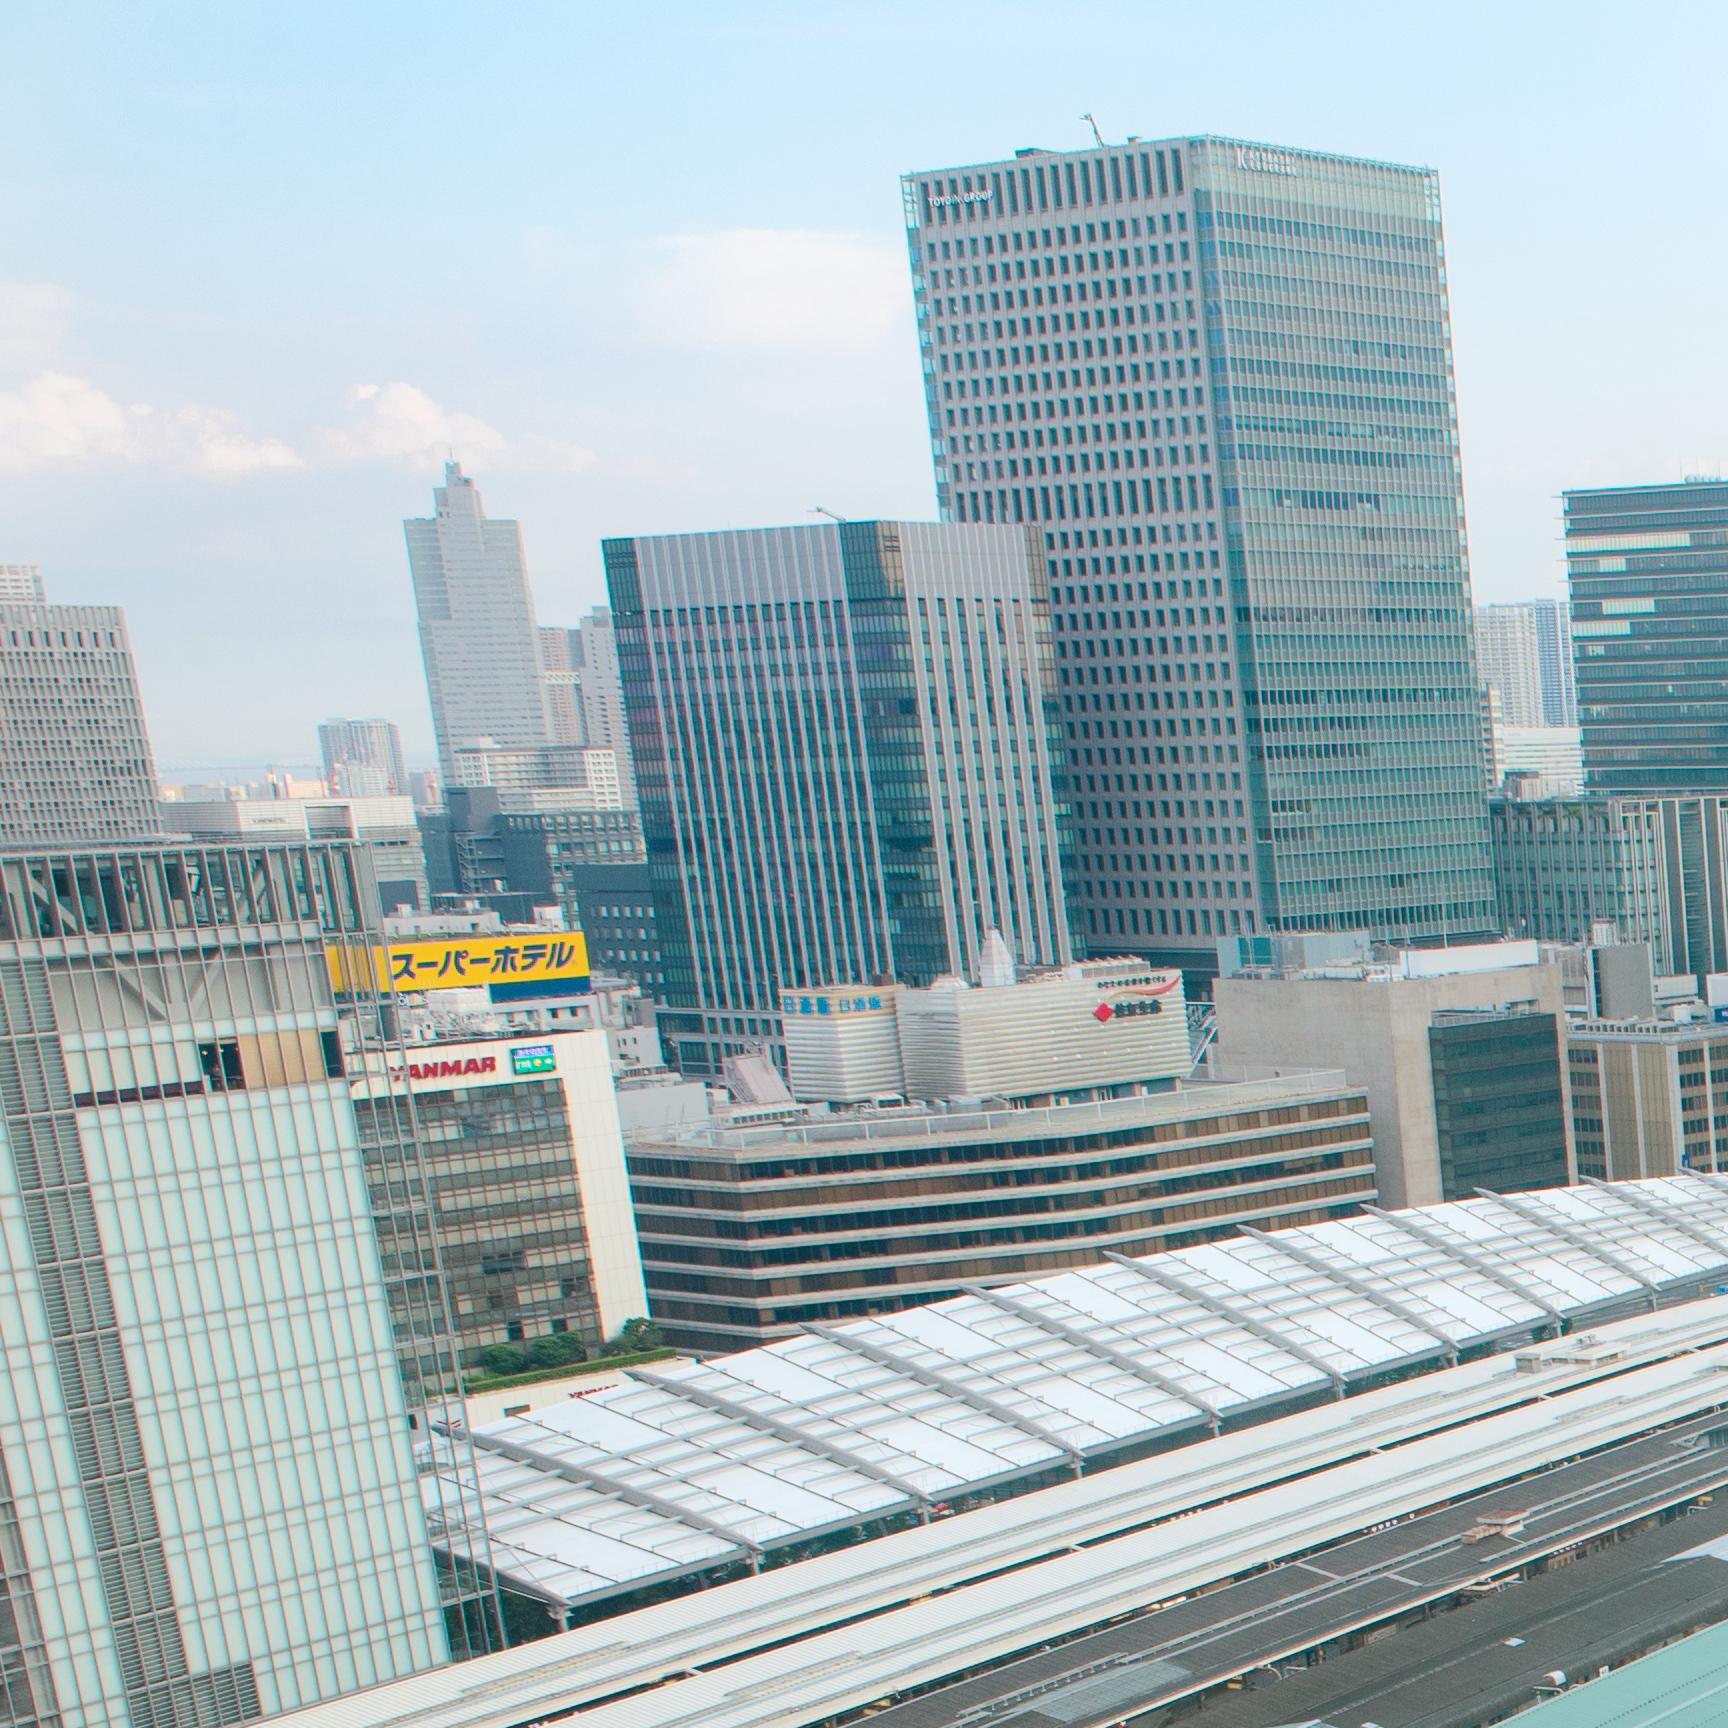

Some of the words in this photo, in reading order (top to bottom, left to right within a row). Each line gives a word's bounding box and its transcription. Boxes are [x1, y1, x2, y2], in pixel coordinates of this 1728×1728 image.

[392, 942, 576, 981] スーパーホテル
